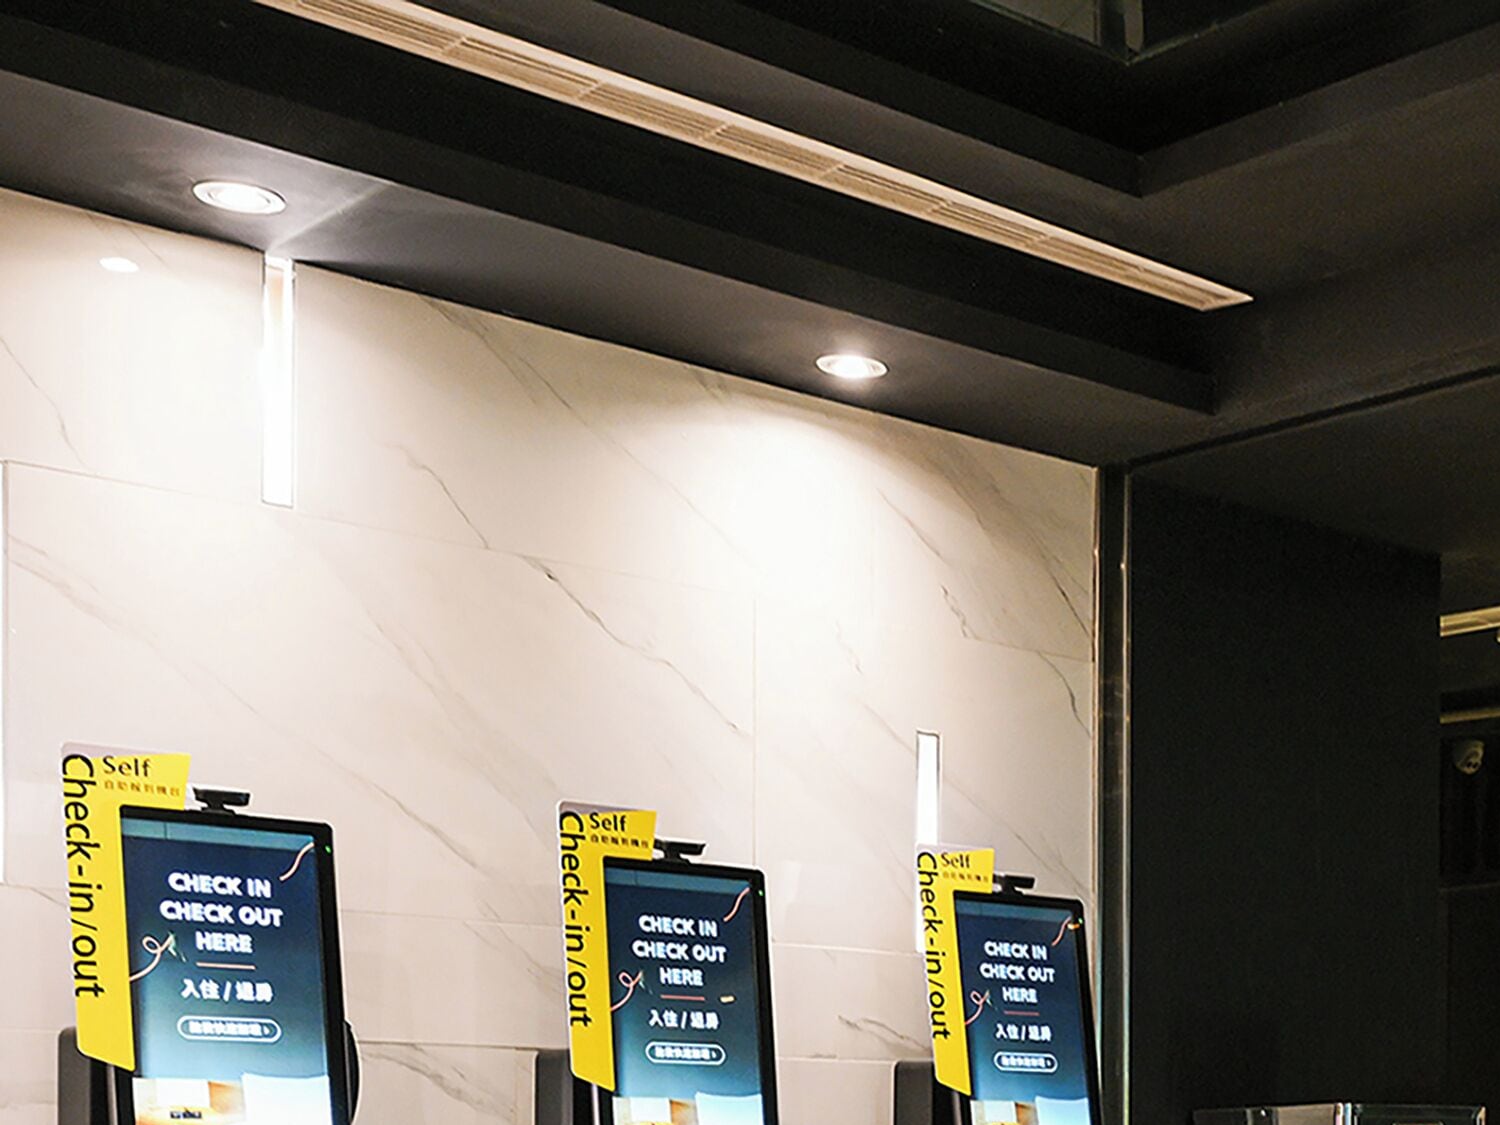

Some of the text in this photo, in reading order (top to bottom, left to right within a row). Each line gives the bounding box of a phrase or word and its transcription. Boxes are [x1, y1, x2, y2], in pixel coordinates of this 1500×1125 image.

[103, 755, 150, 777] Self
[589, 812, 626, 832] Self
[941, 852, 970, 869] Self
[62, 754, 104, 998] Check-in/out
[168, 872, 271, 898] CHECK IN
[159, 900, 283, 928] CHECK OUT
[560, 811, 592, 1027] Check-in/out
[639, 915, 718, 938] CHECK IN
[195, 932, 253, 954] HERE
[632, 940, 727, 964] CHECK OUT
[917, 852, 951, 1040] Check-in/out
[984, 941, 1048, 961] CHECK IN
[659, 967, 704, 987] HERE
[979, 963, 1055, 984] CHECK OUT
[1002, 985, 1038, 1004] HERE
